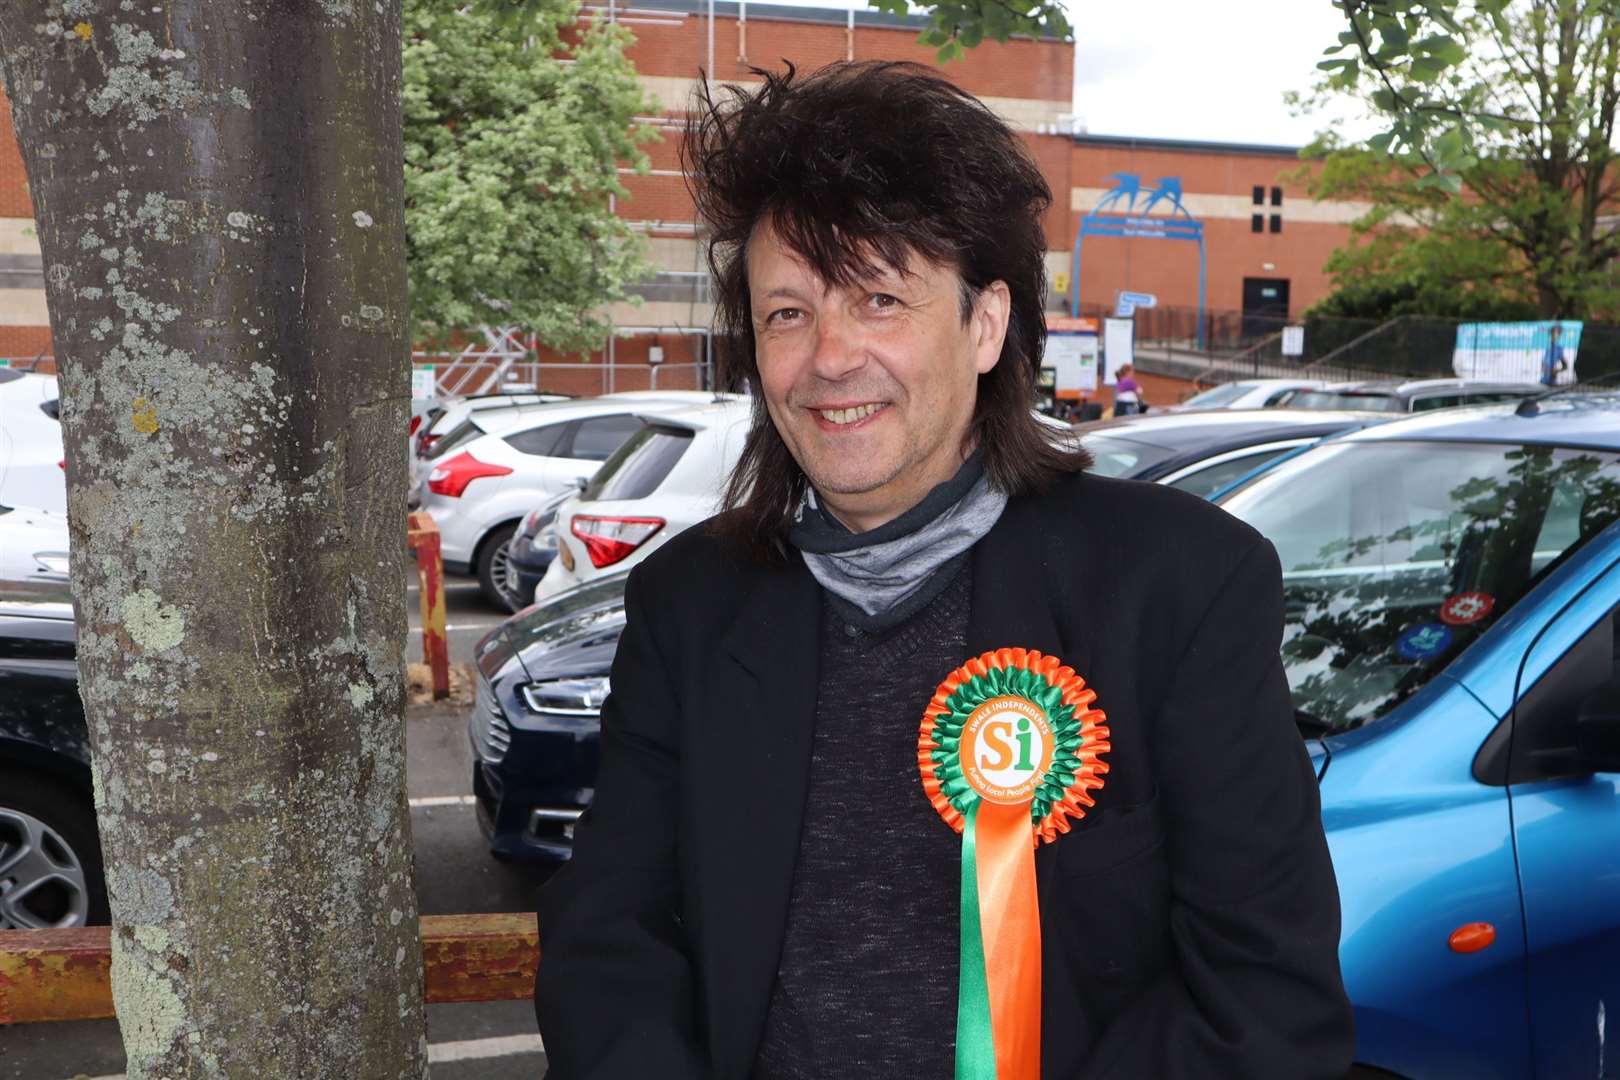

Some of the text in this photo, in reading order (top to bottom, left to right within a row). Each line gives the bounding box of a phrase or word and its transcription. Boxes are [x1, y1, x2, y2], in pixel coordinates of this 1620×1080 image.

[969, 701, 1049, 735] SWALE INDEPENDENTS
[981, 718, 1035, 771] Si
